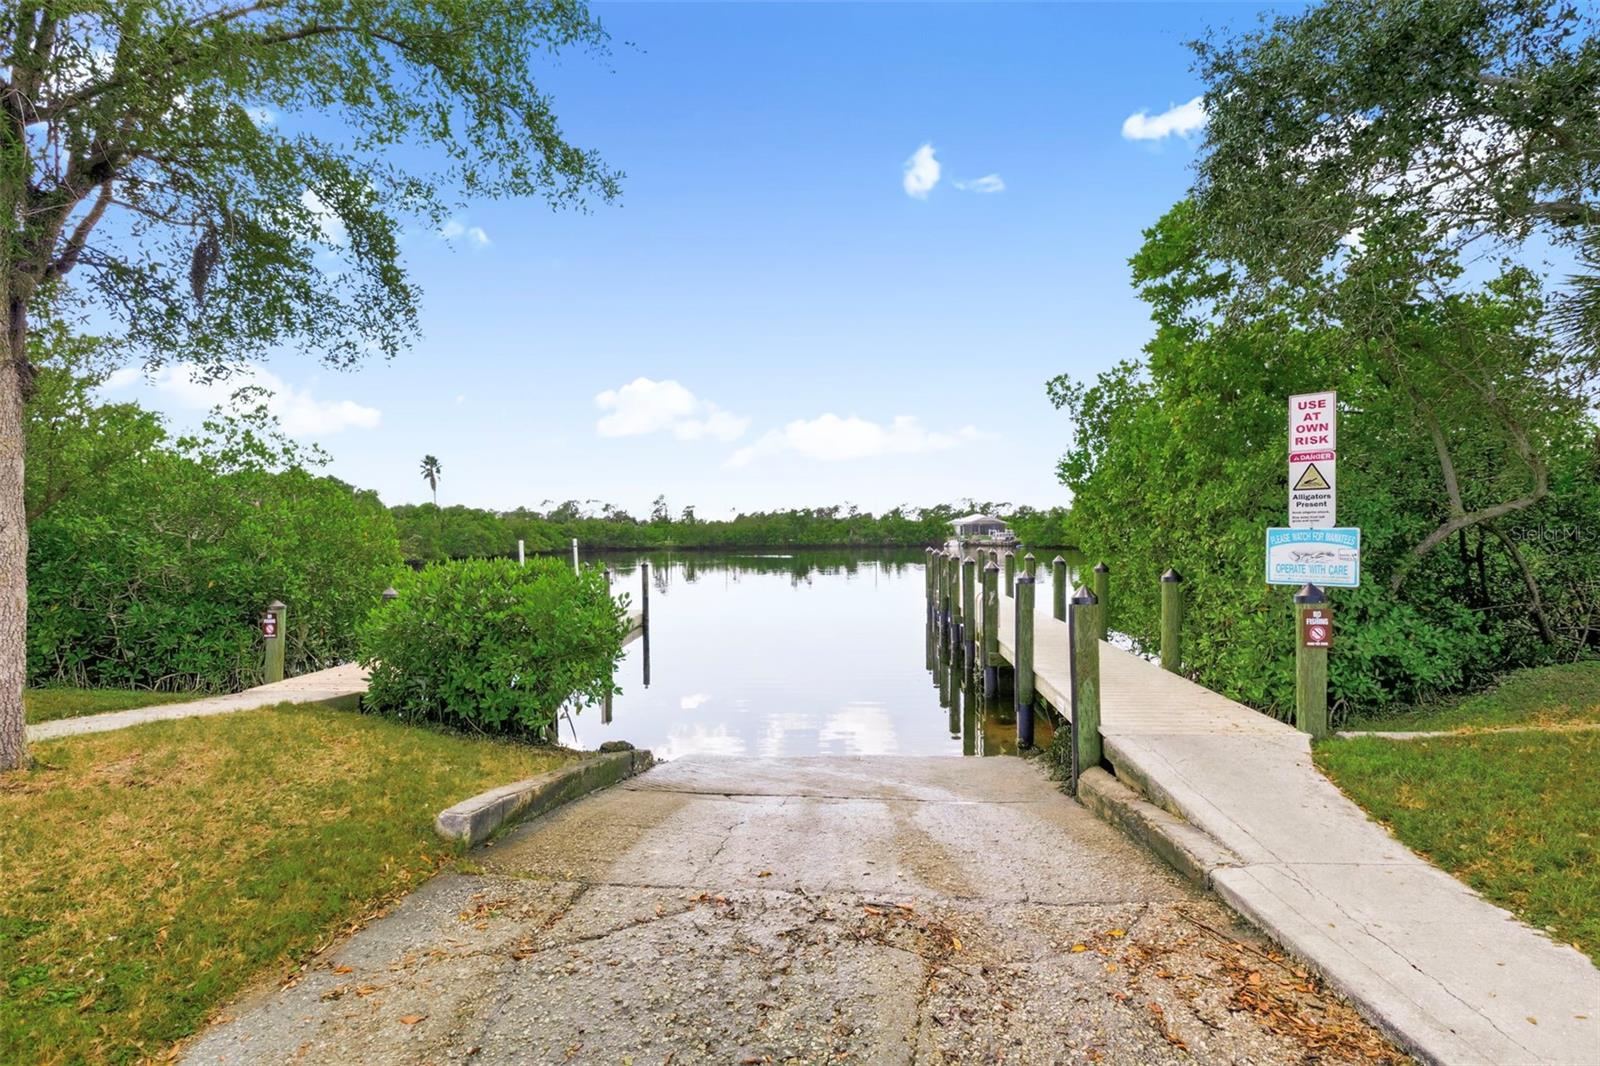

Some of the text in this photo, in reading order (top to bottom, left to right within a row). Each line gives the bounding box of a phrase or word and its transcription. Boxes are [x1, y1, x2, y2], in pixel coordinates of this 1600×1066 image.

[1298, 400, 1326, 410] USE
[1303, 412, 1321, 421] AT
[1296, 423, 1328, 433] OWN
[1295, 435, 1328, 445] RISK
[1300, 453, 1331, 461] DANGER
[1293, 493, 1331, 501] Alligators
[1270, 533, 1290, 545] PLEASE
[1312, 531, 1324, 541] FOR
[1275, 563, 1349, 576] OPERATE WITH CARE
